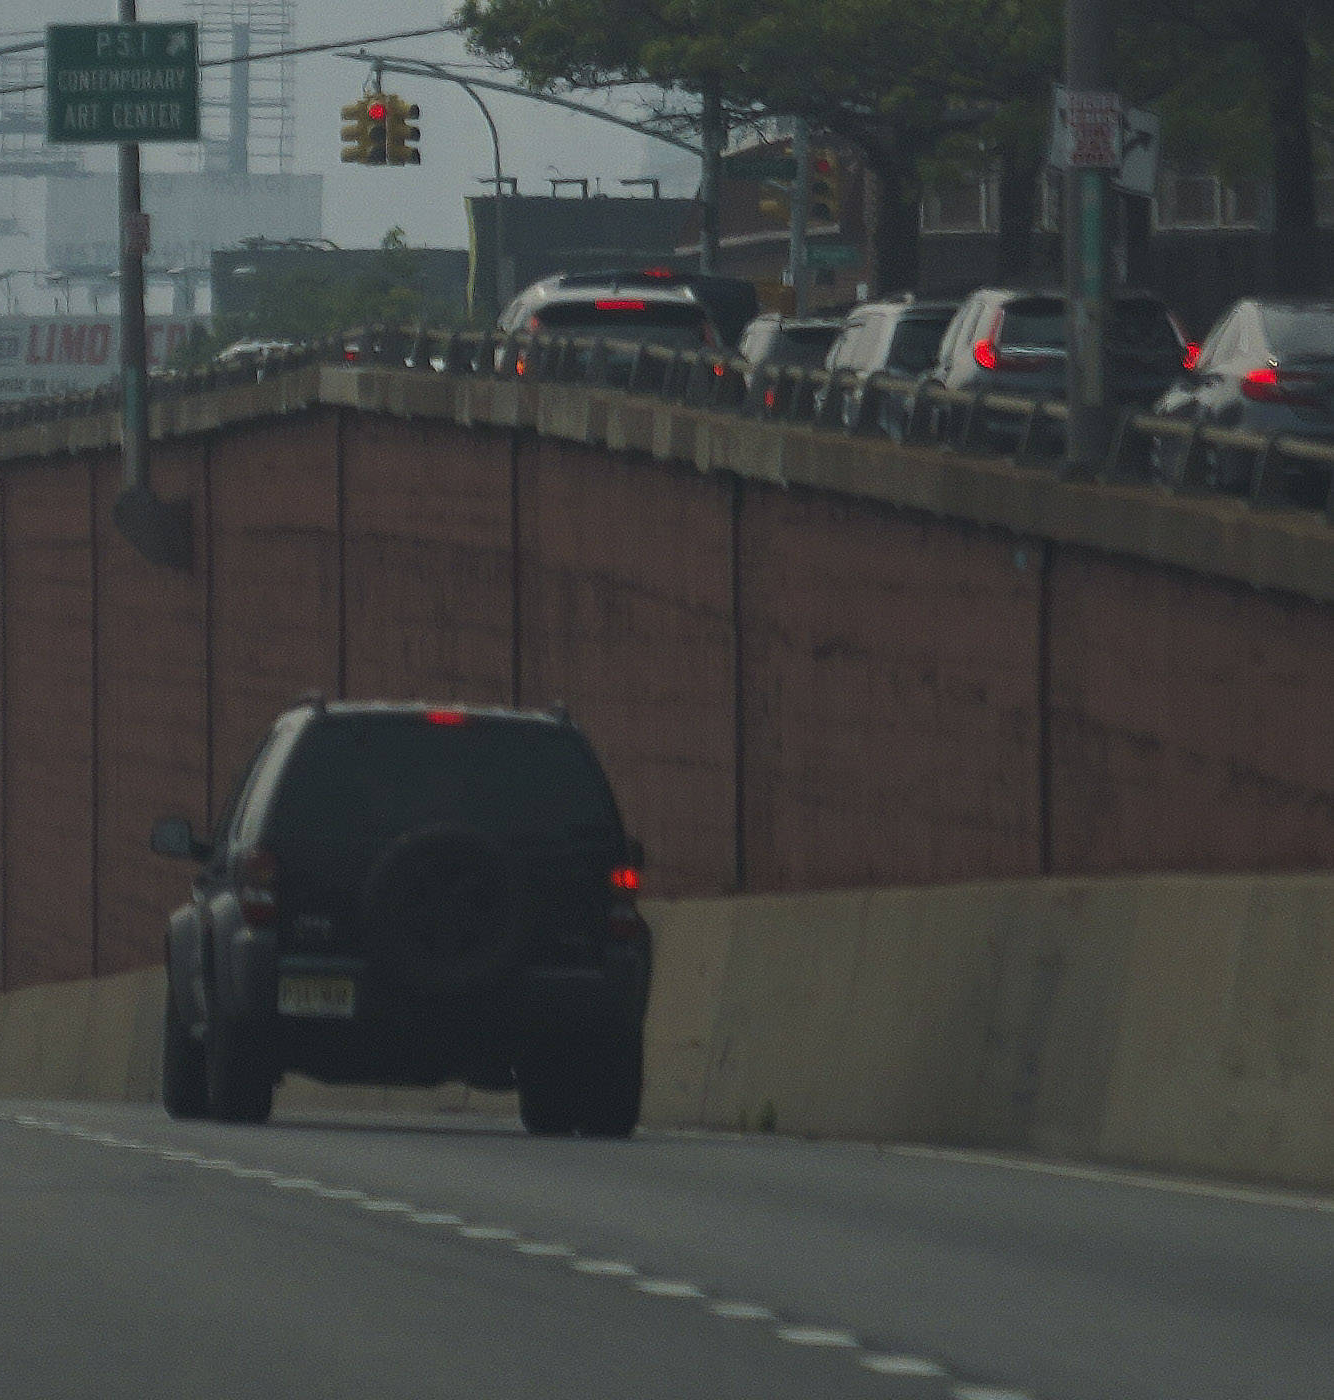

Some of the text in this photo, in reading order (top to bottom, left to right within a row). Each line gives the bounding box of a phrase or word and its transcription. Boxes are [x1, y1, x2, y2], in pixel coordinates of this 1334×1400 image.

[57, 66, 187, 93] CONTEMPORARY
[63, 102, 182, 131] ART CENTER
[24, 323, 112, 366] LIMO
